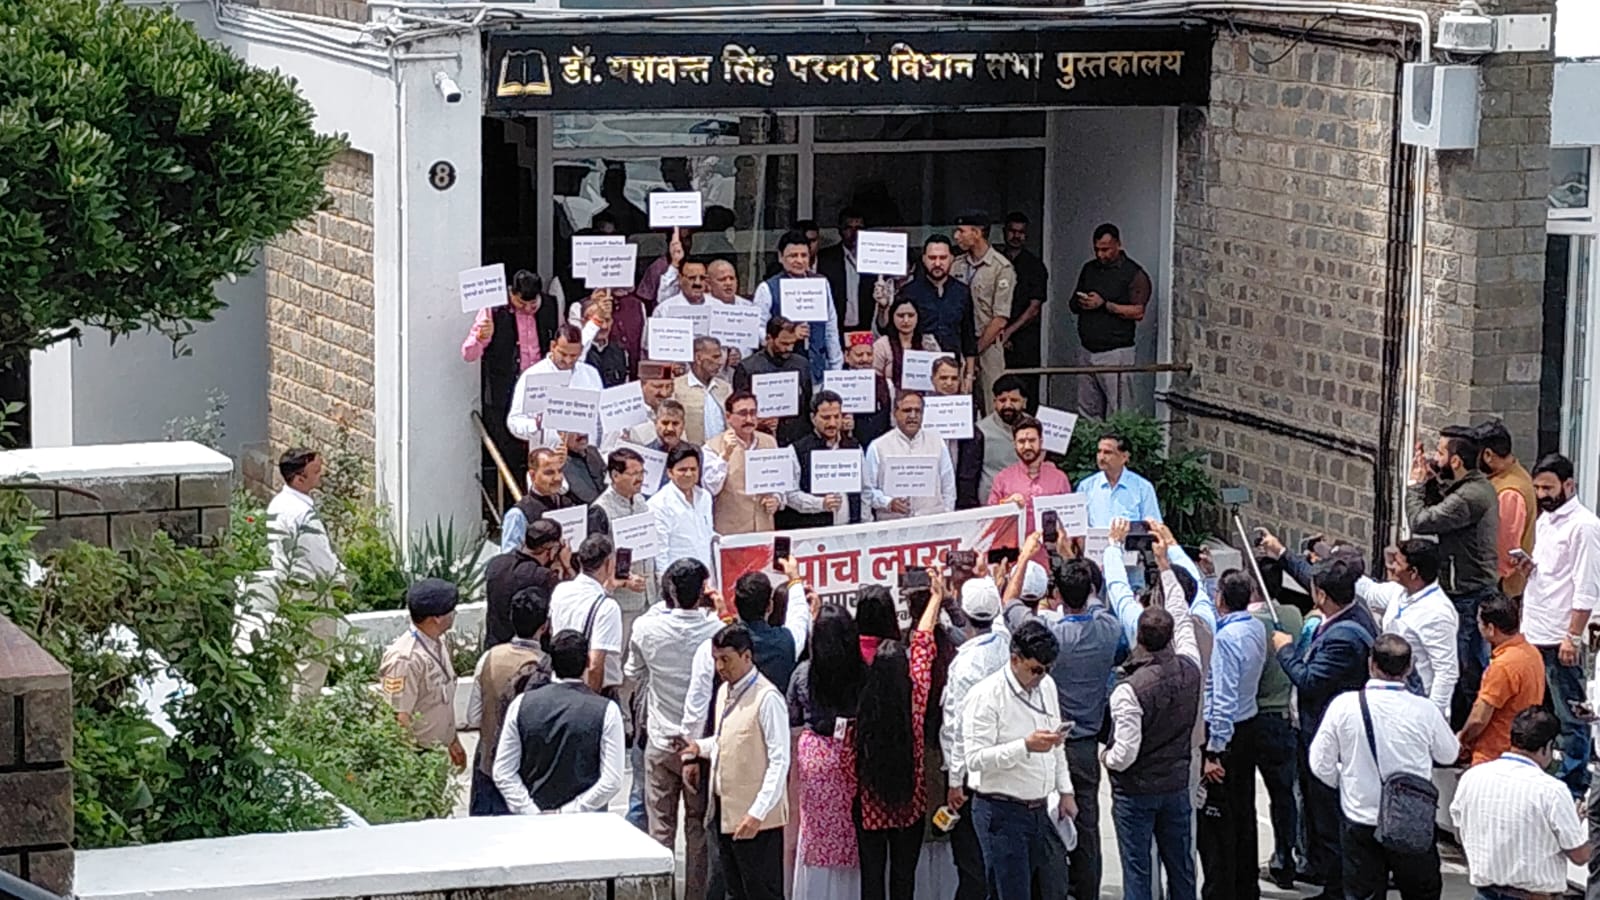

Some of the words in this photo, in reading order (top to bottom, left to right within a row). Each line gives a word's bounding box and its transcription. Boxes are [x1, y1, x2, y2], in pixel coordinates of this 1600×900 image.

[559, 45, 603, 84] डॉ.
[606, 55, 713, 84] यशवन्त
[721, 44, 778, 86] सिंह
[787, 53, 881, 84] परमार
[888, 43, 977, 82] विधान
[984, 52, 1045, 81] सभा
[1056, 50, 1185, 89] पुस्तकालय
[434, 163, 450, 187] 8
[794, 543, 862, 588] पांच
